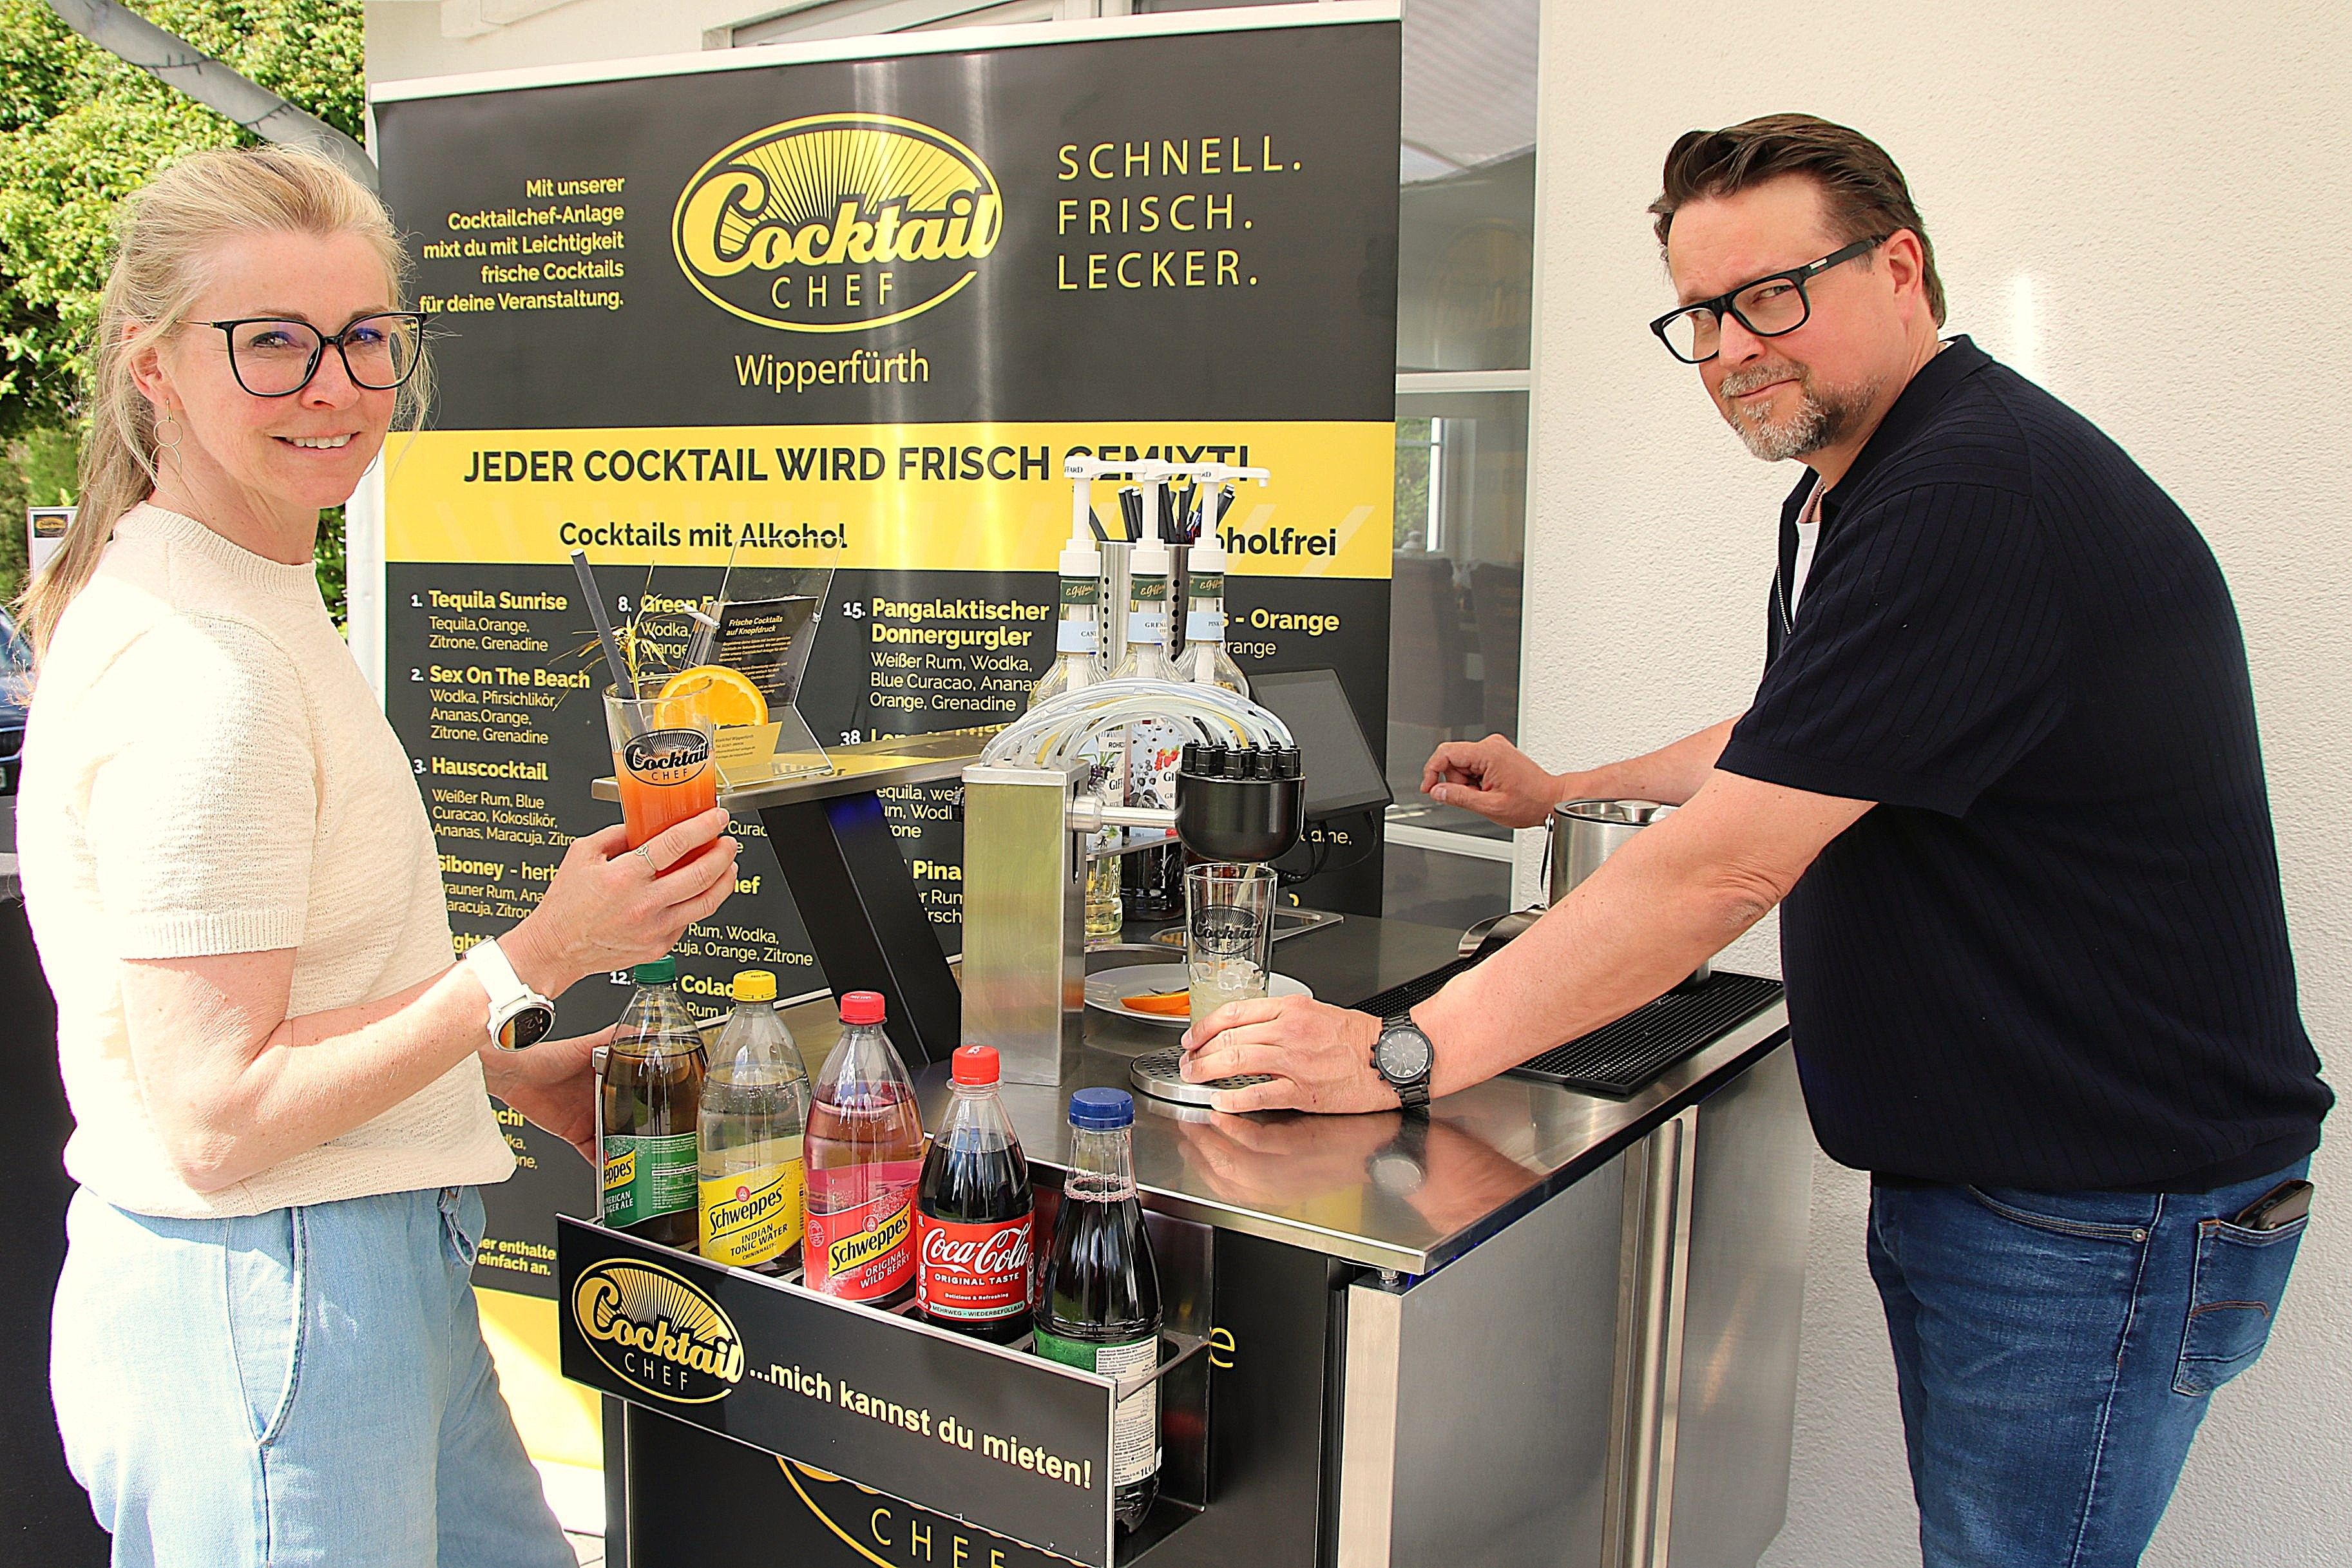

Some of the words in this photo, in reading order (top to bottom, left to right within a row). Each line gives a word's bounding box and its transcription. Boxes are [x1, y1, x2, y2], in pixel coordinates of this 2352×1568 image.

[1057, 135, 1302, 180] SCHNELL.
[526, 180, 553, 198] Mit
[557, 177, 626, 195] unserer
[448, 204, 625, 231] Cocktailchef-Anlage
[682, 170, 999, 278] Cocktail
[1057, 194, 1254, 235] FRISCH.
[423, 240, 461, 259] mixt
[464, 238, 487, 257] du
[490, 237, 518, 256] mit
[521, 232, 625, 258] Leichtigkeit
[481, 265, 540, 284] frische
[542, 262, 624, 281] Cocktails
[1057, 250, 1259, 291] LECKER.
[419, 295, 444, 313] für
[446, 294, 495, 312] deine
[497, 289, 624, 312] Veranstaltung.
[770, 271, 894, 310] CHEF
[734, 348, 930, 394] Wipperfürth
[464, 450, 573, 483] JEDER
[584, 448, 768, 482] COCKTAIL
[776, 447, 886, 481] WIRD
[898, 446, 1050, 481] FRISCH
[559, 522, 681, 548] Cocktails
[689, 523, 732, 548] mit
[740, 523, 848, 549] Alkohol
[410, 593, 423, 607] 1.
[428, 589, 495, 613] Tequila
[499, 591, 568, 611] Sunrise
[618, 595, 633, 612] 8.
[640, 594, 698, 613] Green
[842, 602, 866, 619] 15.
[872, 597, 1050, 623] Pangalaktischer
[725, 627, 739, 636] auf
[738, 624, 777, 636] Knopfdruck
[729, 618, 753, 627] Frische
[753, 615, 783, 624] Cocktails
[1250, 608, 1341, 636] Orange
[428, 634, 479, 650] Zitrone,
[481, 636, 548, 652] Grenadine
[871, 623, 1033, 651] Donnergurgler
[1225, 640, 1277, 659] range
[870, 651, 923, 669] Weißer
[925, 653, 966, 672] Rum,
[970, 655, 1033, 673] Wodka,
[410, 668, 424, 682] 2.
[429, 665, 463, 684] Sex
[466, 666, 493, 684] On
[495, 667, 530, 685] The
[533, 668, 591, 689] Beach
[870, 671, 904, 689] Blue
[906, 674, 977, 692] Curacao,
[430, 688, 479, 705] Wodka,
[482, 690, 558, 707] Pfirsichlikör,
[870, 691, 928, 712] Orange,
[931, 694, 1017, 712] Grenadine
[430, 725, 480, 741] Zitrone,
[483, 728, 549, 744] Grenadine
[413, 758, 427, 774] 3.
[431, 756, 549, 781] Hauscocktail
[626, 741, 709, 772] Cocktail
[651, 768, 689, 781] CHEF
[431, 788, 479, 804] Weißer
[480, 791, 513, 808] Rum,
[515, 794, 545, 809] Blue
[876, 784, 926, 803] equila,
[432, 806, 490, 823] Curacao,
[492, 810, 558, 828] Kokoslikör,
[434, 823, 483, 839] Ananas,
[486, 827, 546, 846] Maracuja,
[437, 854, 504, 881] Siboney
[444, 883, 484, 897] rauner
[486, 884, 517, 901] Rum,
[447, 901, 493, 917] aracuja,
[688, 922, 723, 941] Rum,
[725, 925, 779, 945] Wodka,
[705, 942, 760, 963] Orange,
[763, 947, 813, 966] Zitrone
[609, 971, 631, 985] 12.
[620, 1198, 633, 1209] ALE
[709, 1186, 783, 1236] Schweppes
[730, 1240, 756, 1256] TONIC
[758, 1223, 788, 1248] WATER
[741, 1223, 774, 1243] INDIAN
[831, 1213, 909, 1271] Schweppes
[741, 1241, 777, 1260] CHININHALTIG
[922, 1221, 1033, 1275] Coca-Cola
[478, 1252, 528, 1272] einfach
[530, 1263, 552, 1276] an.
[860, 1268, 886, 1289] WILD
[886, 1251, 911, 1277] BERRY
[865, 1247, 906, 1278] ORIGINAL
[934, 1273, 985, 1286] ORIGINAL
[989, 1272, 1019, 1285] TASTE
[944, 1292, 971, 1301] Delicious
[978, 1292, 1009, 1301] Refreshing
[933, 1305, 962, 1316] MEHRWEG
[968, 1303, 1024, 1317] WIEDERBEFÜLLBAR
[578, 1277, 741, 1383] Cocktail
[624, 1352, 688, 1391] CHEF
[840, 1379, 931, 1437] kannst
[939, 1416, 974, 1450] du
[982, 1435, 1092, 1490] mieten!
[870, 1507, 1006, 1568] CHEF
